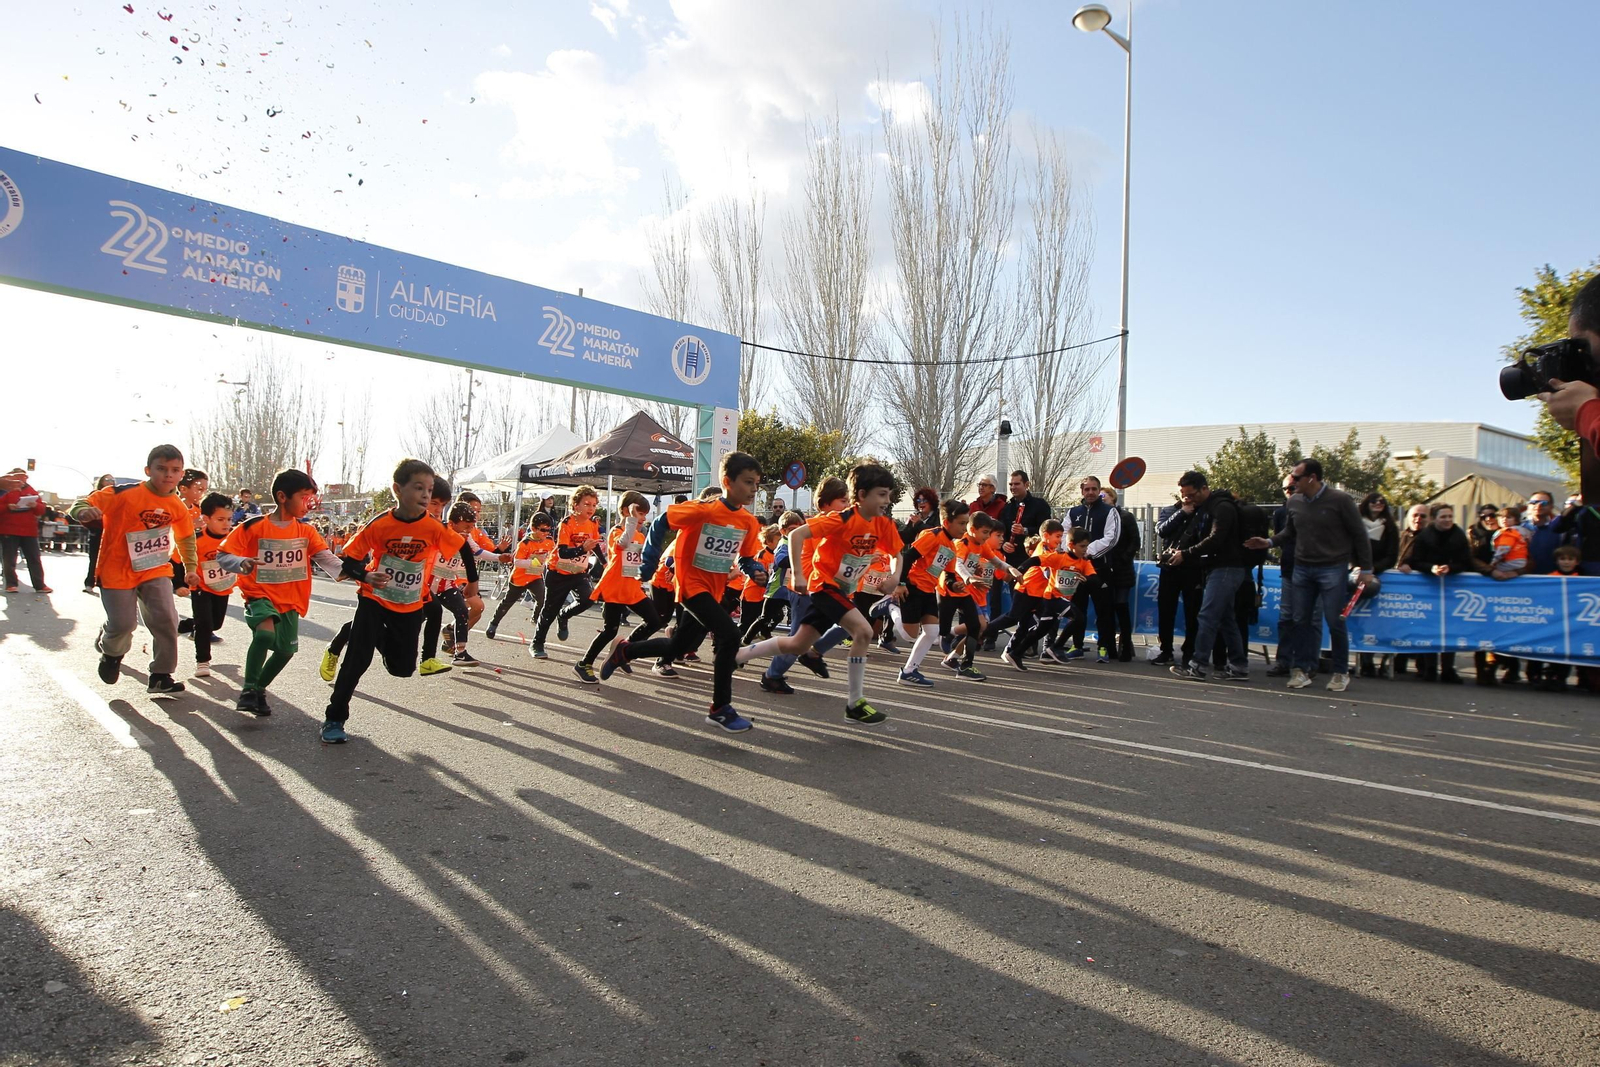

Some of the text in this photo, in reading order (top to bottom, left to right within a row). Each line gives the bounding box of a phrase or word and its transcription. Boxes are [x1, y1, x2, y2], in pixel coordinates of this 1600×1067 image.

[184, 229, 249, 256] MEDIO
[183, 247, 281, 282] MARATÓN
[182, 265, 271, 295] ALMERÍA
[390, 280, 497, 322] ALMERÍA
[389, 303, 446, 327] CIUDAD
[584, 322, 621, 340] MEDIO
[583, 336, 639, 358] MARATÓN
[582, 350, 633, 369] ALMERÍA
[134, 535, 170, 553] 8443
[704, 536, 740, 554] 8292
[263, 549, 303, 564] 8190
[384, 567, 422, 586] 8099
[1378, 593, 1413, 601] MEDIO
[1378, 599, 1433, 611] MARATÓN
[1494, 596, 1533, 605] MEDIO
[1378, 609, 1427, 619] ALMERÍA
[1494, 603, 1554, 616] MARATÓN
[1494, 613, 1548, 625] ALMERÍA
